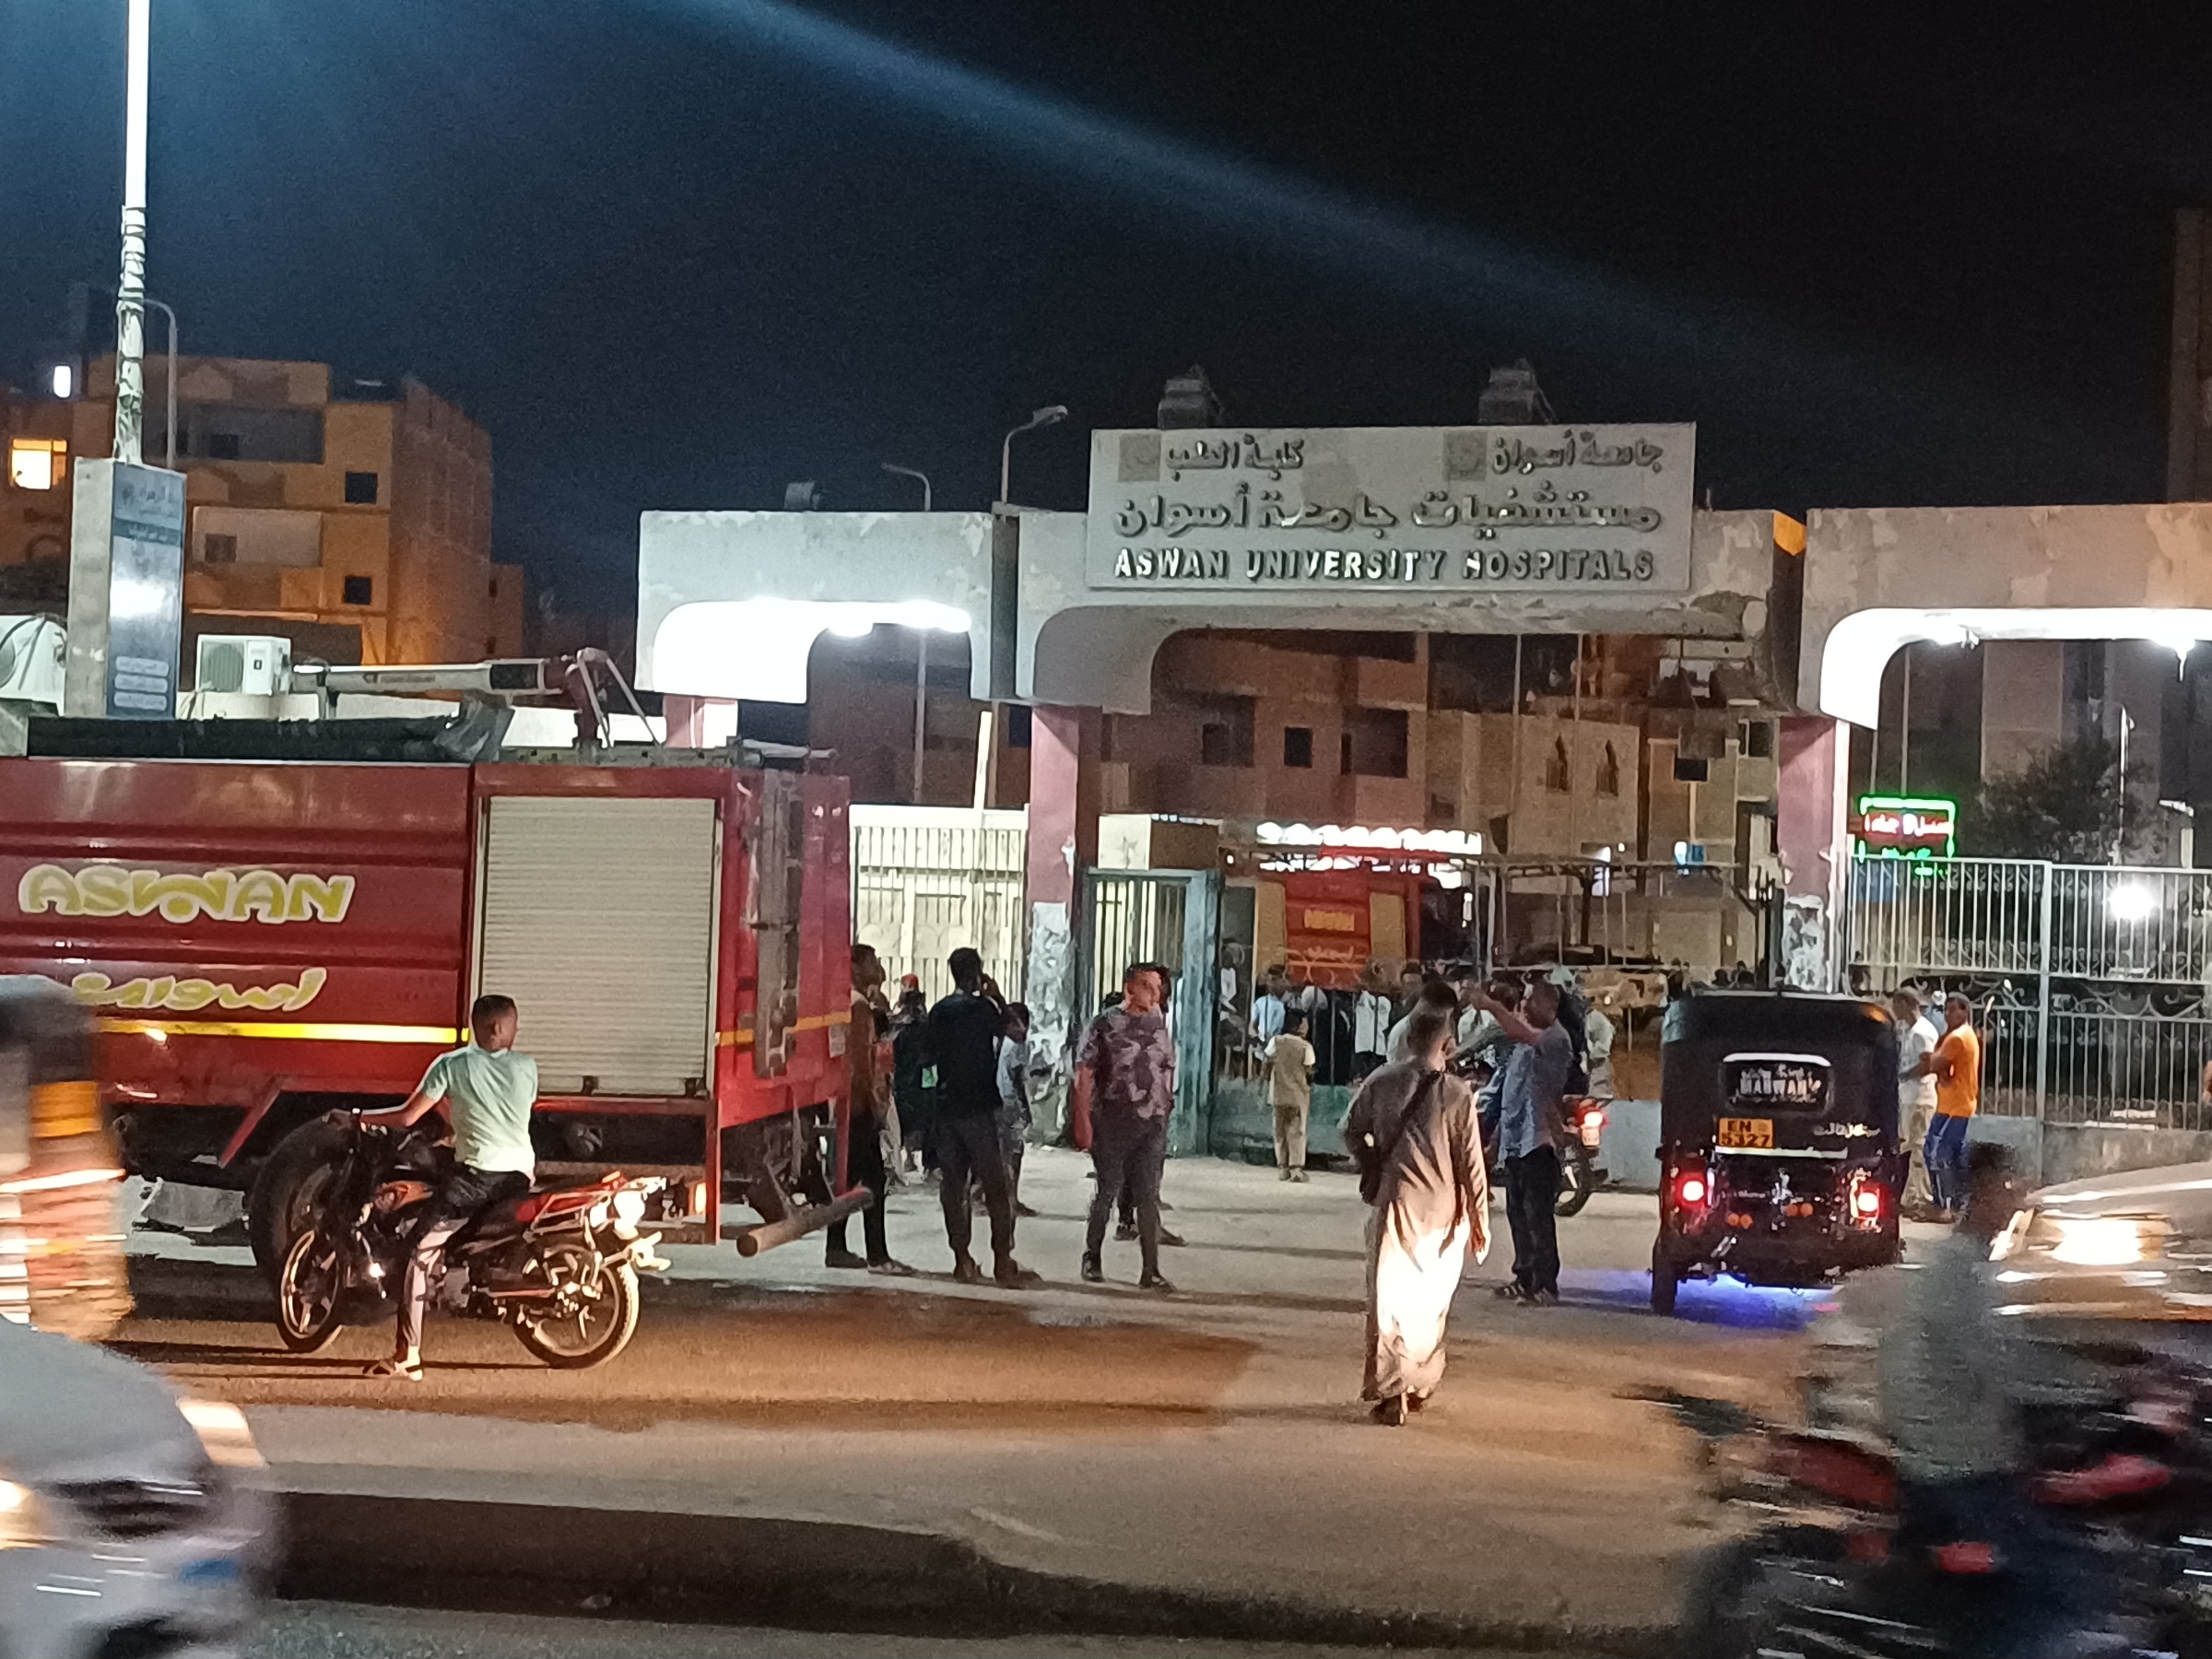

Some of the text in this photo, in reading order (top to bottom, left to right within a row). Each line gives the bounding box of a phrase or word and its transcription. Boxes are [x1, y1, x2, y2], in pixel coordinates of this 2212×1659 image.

[1167, 433, 1305, 481] كلية الطب
[1581, 430, 1663, 474] جامعة
[1113, 479, 1662, 540] مستشفيات جامعة أسوان
[1113, 547, 1654, 582] ASWAN UNIVERSITY HOSPITALS
[18, 864, 356, 923] ASWAN
